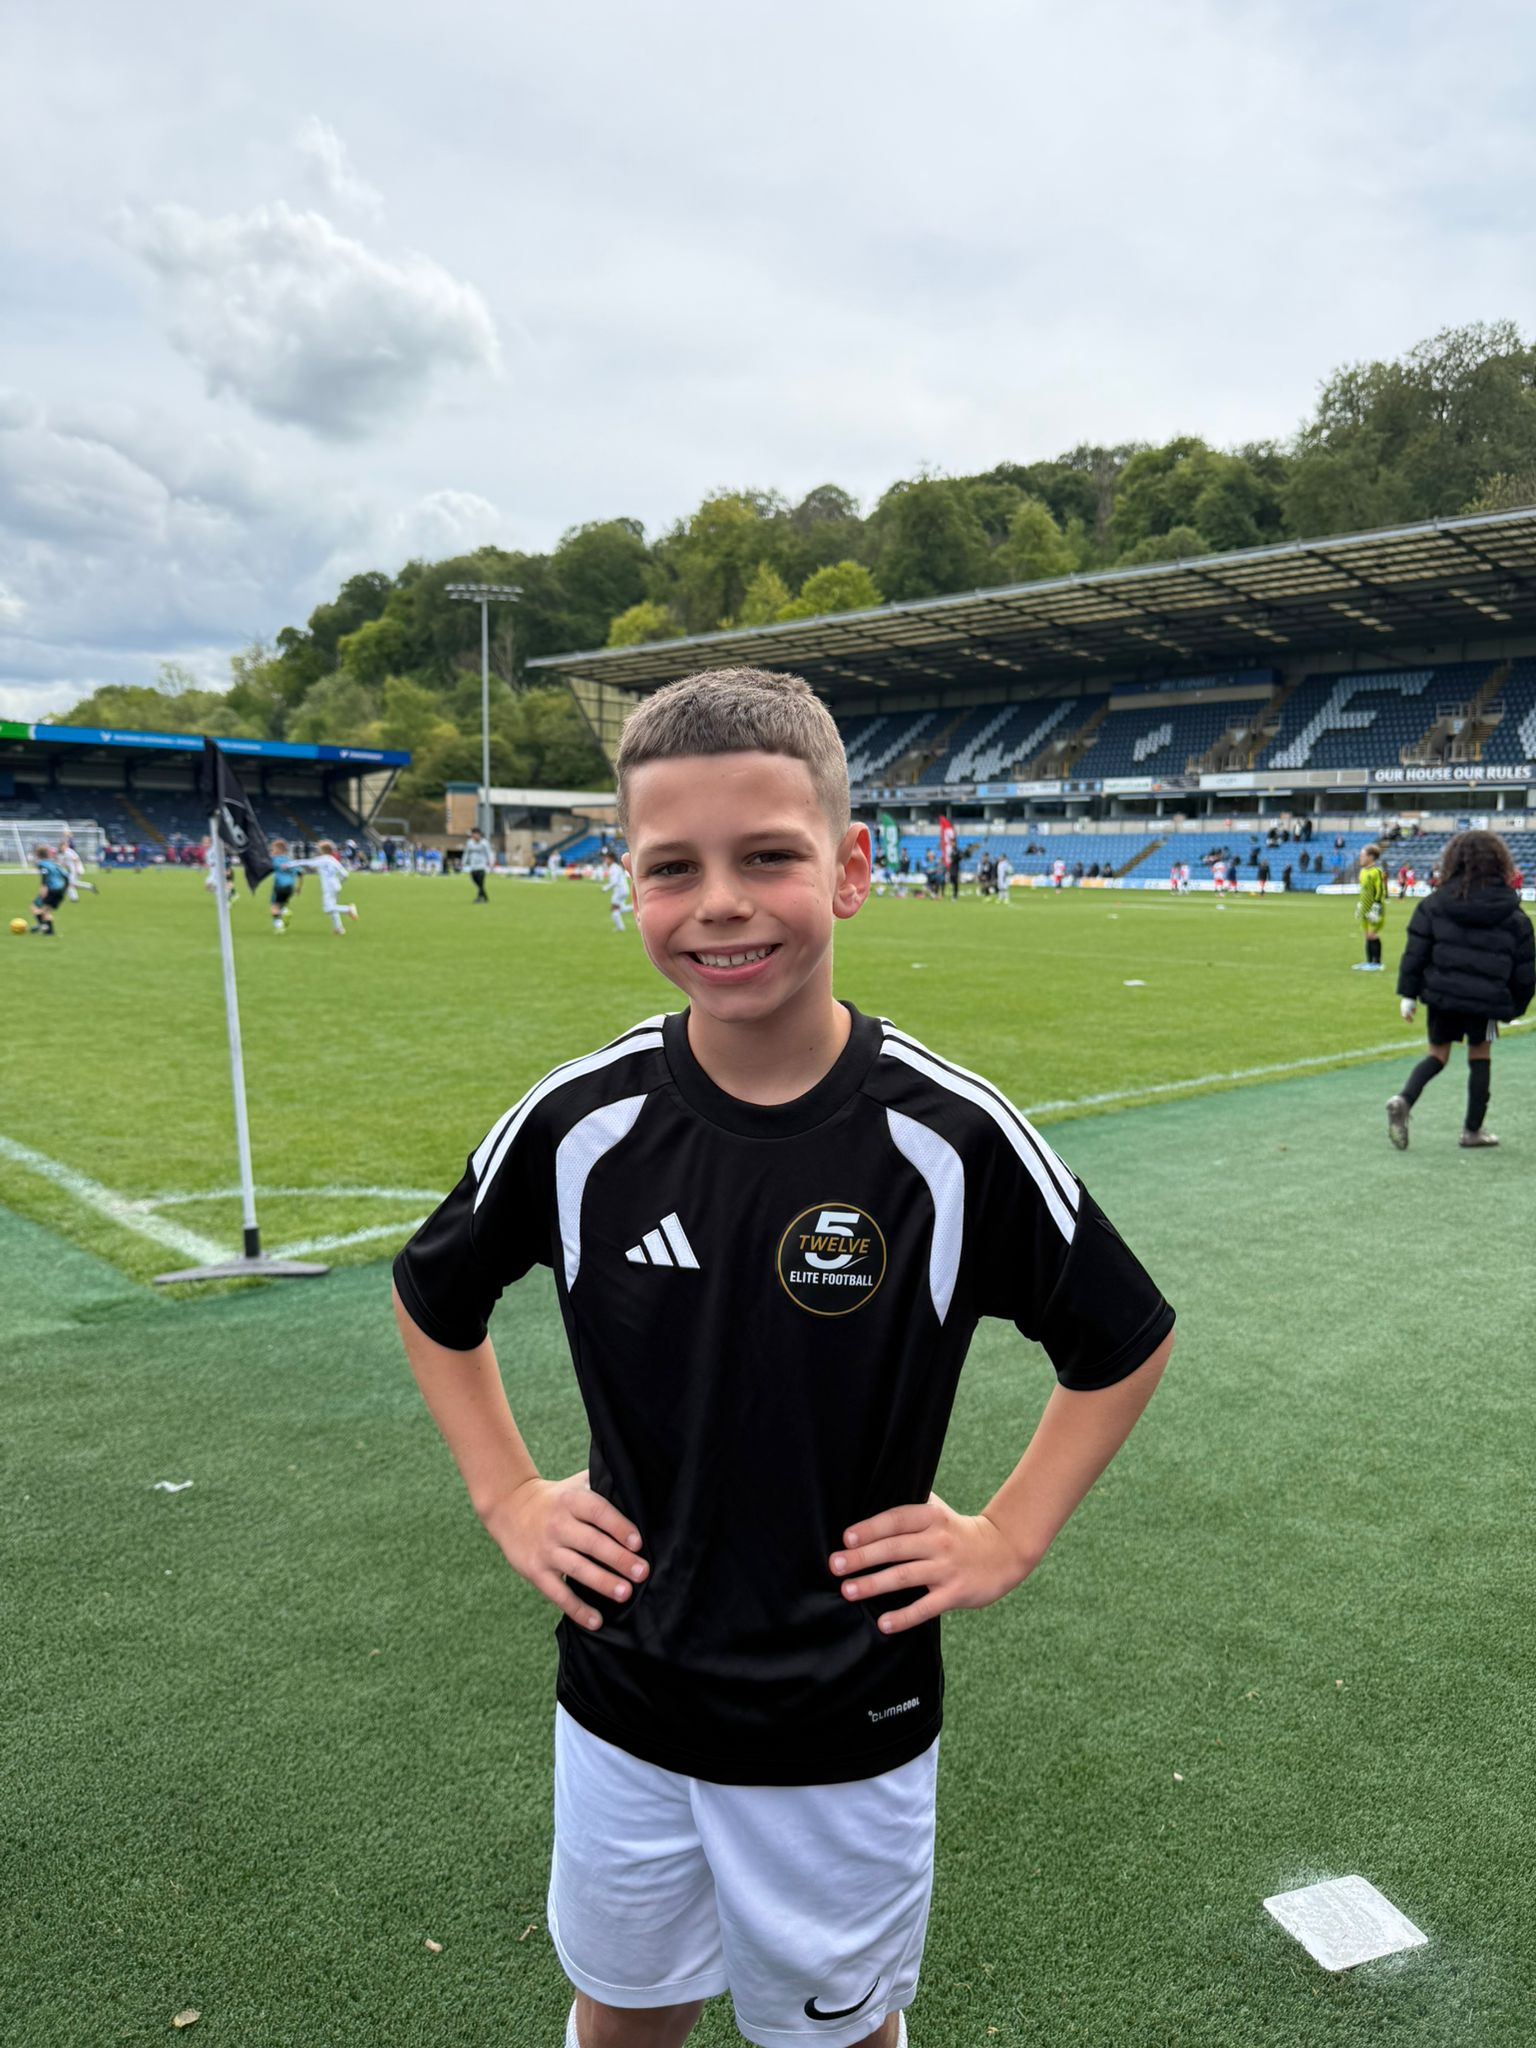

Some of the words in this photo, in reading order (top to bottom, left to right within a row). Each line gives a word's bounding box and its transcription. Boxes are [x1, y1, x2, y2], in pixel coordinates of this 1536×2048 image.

[1375, 768, 1404, 782] OUR
[1406, 767, 1452, 781] HOUSE
[1454, 766, 1484, 780] OUR
[1486, 765, 1531, 779] RULES
[799, 1234, 871, 1254] TWELVE
[789, 1270, 820, 1285] ELITE
[822, 1272, 874, 1287] FOOTBALL
